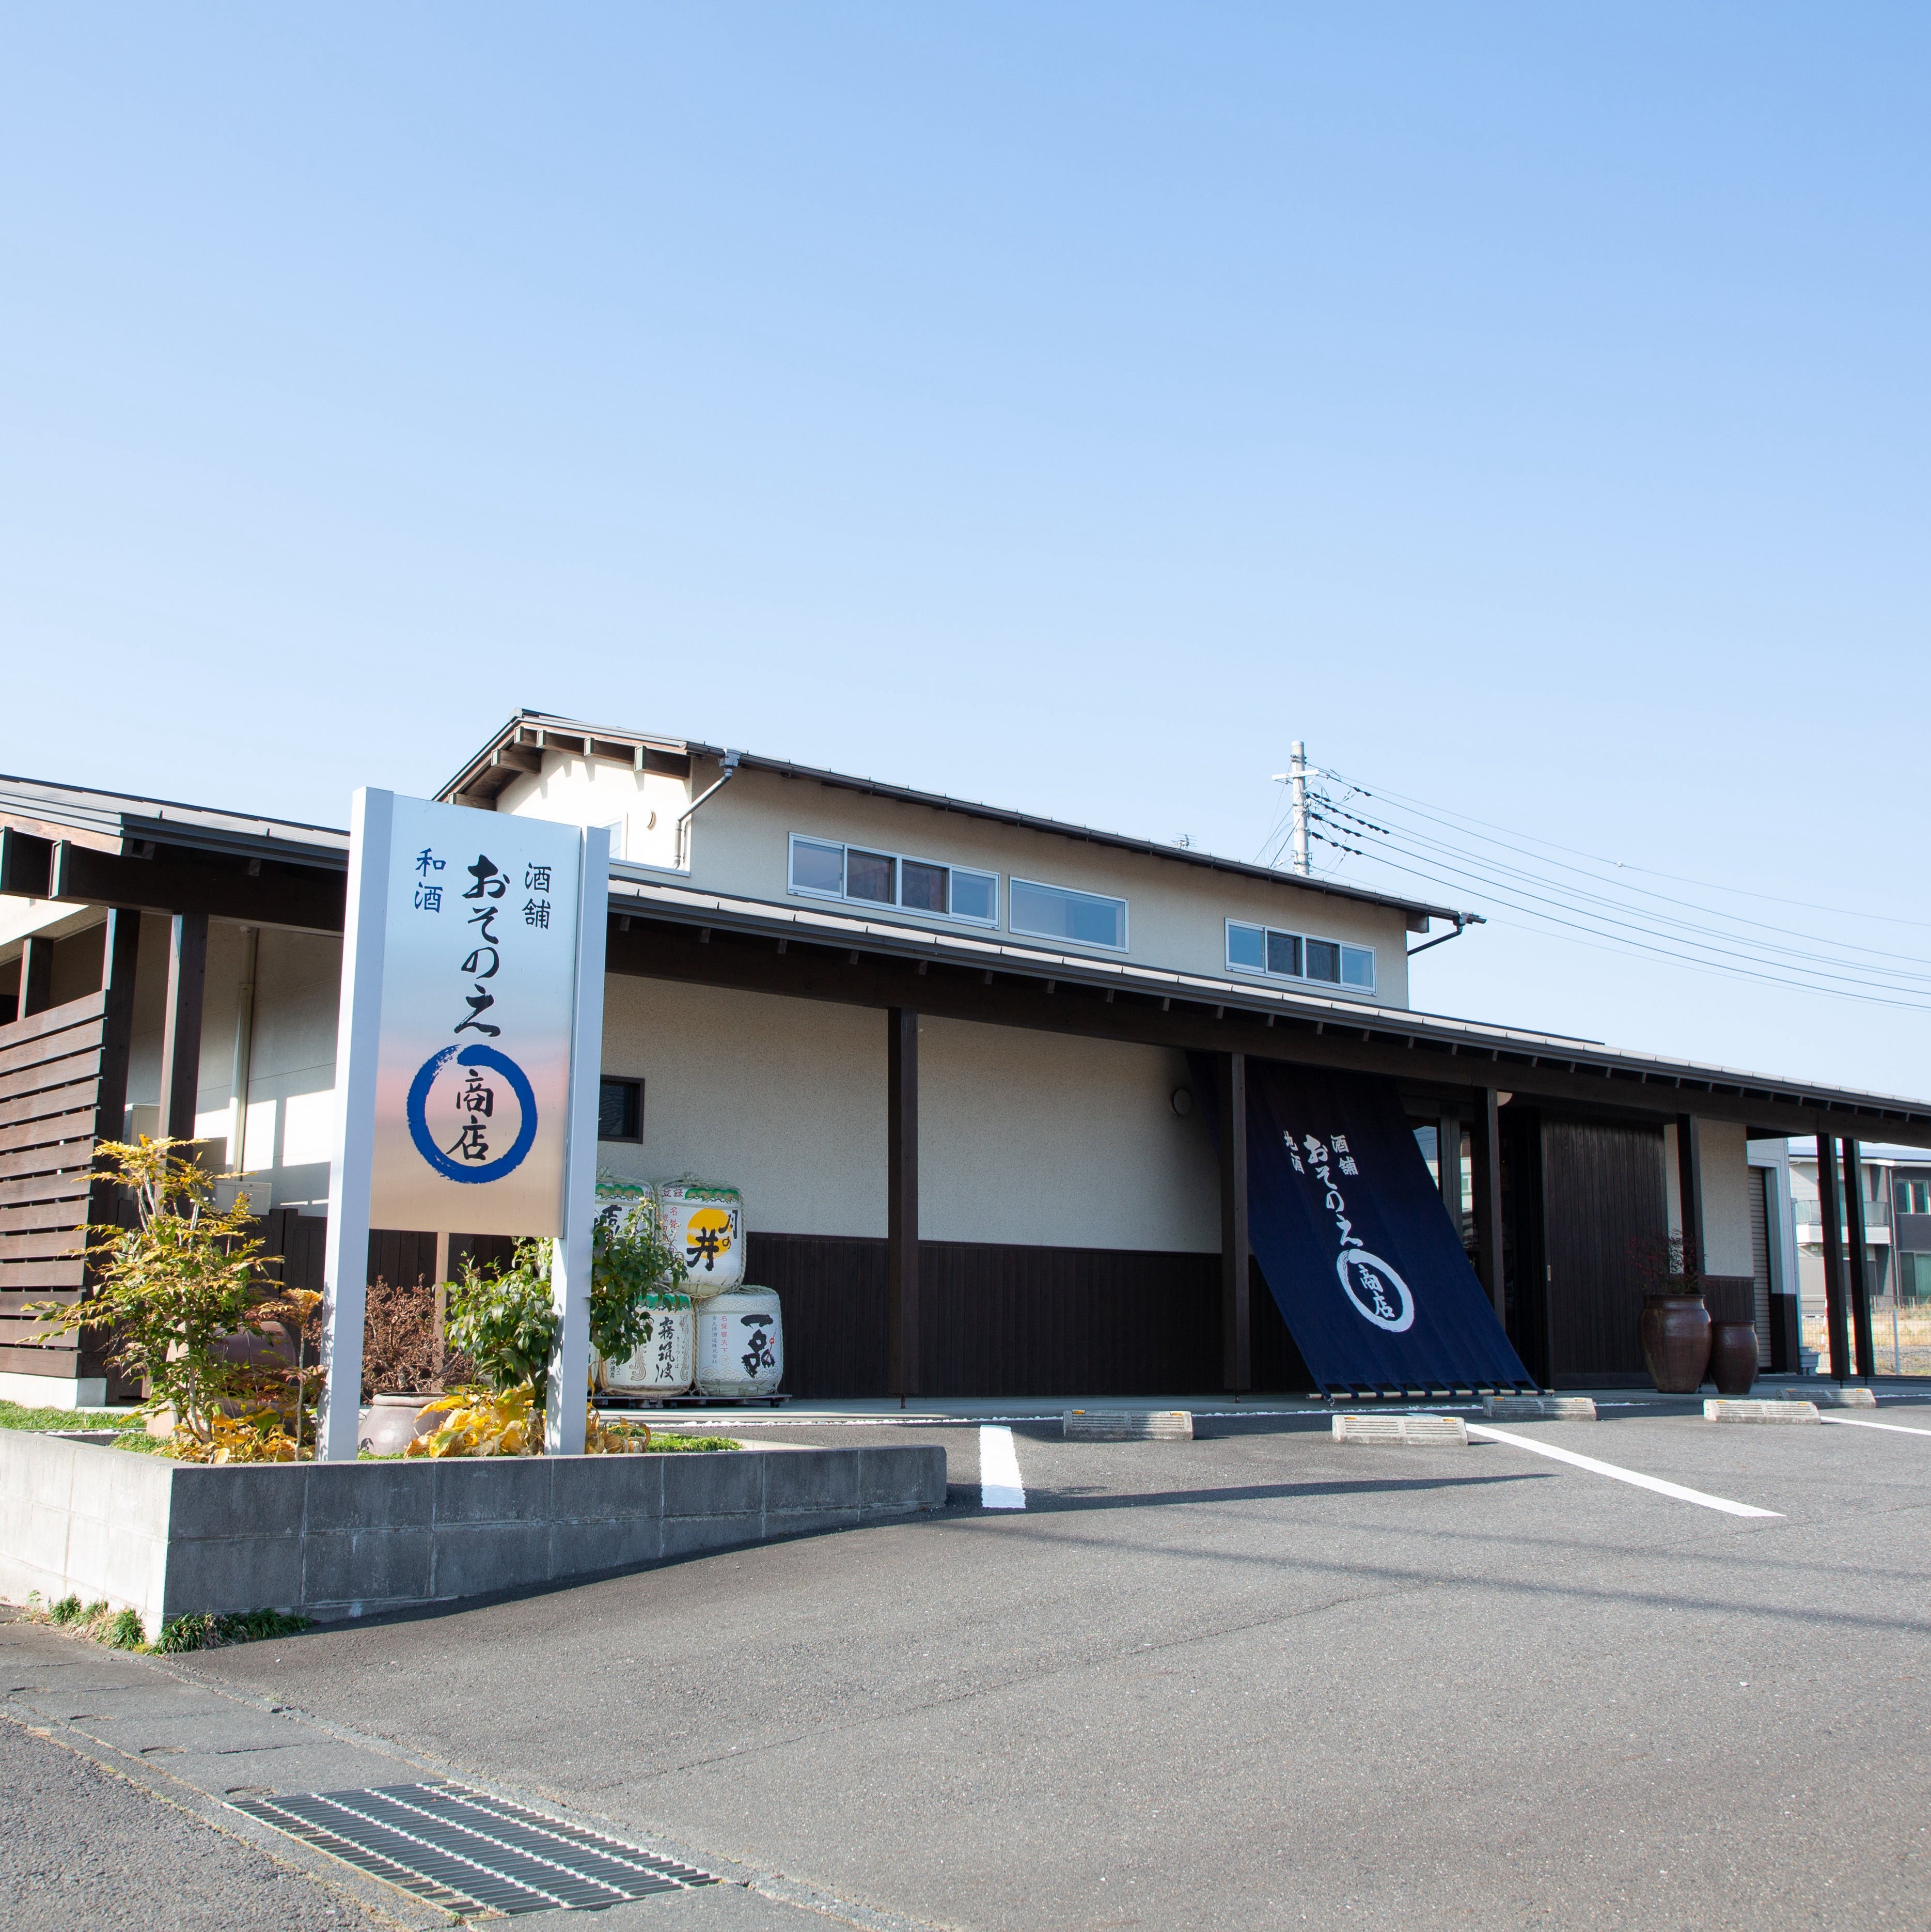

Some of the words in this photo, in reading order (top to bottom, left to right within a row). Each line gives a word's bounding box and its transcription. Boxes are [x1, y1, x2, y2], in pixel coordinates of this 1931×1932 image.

[415, 848, 446, 913] 和酒
[522, 862, 552, 930] 酒舗
[454, 854, 510, 1037] おそのえ
[446, 1069, 494, 1161] 商店
[1283, 1130, 1305, 1174] 地酒
[1330, 1134, 1359, 1176] 酒舗
[1303, 1134, 1363, 1247] おそのえ
[1358, 1264, 1395, 1318] 商店
[740, 1314, 774, 1379] 一品
